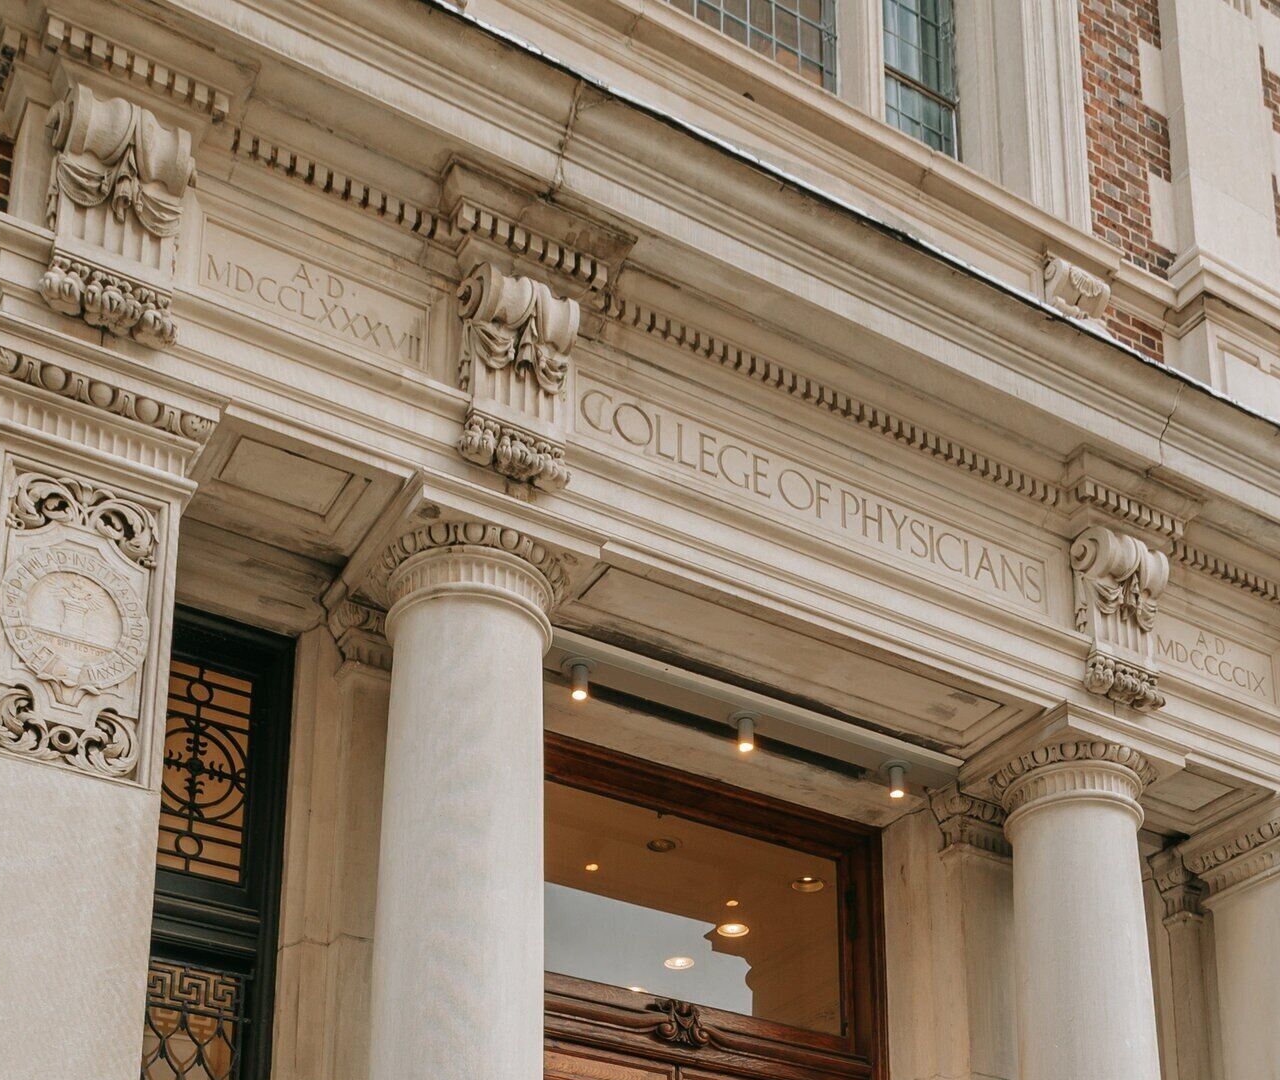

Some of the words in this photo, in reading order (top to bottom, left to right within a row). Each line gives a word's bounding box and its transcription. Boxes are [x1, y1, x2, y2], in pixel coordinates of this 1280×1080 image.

[207, 253, 421, 363] MDCCLXXXVII
[580, 388, 771, 500] COLLEGE
[777, 468, 832, 520] OF
[840, 488, 1044, 604] PHYSICIANS
[1157, 634, 1266, 697] MDCCCCIX
